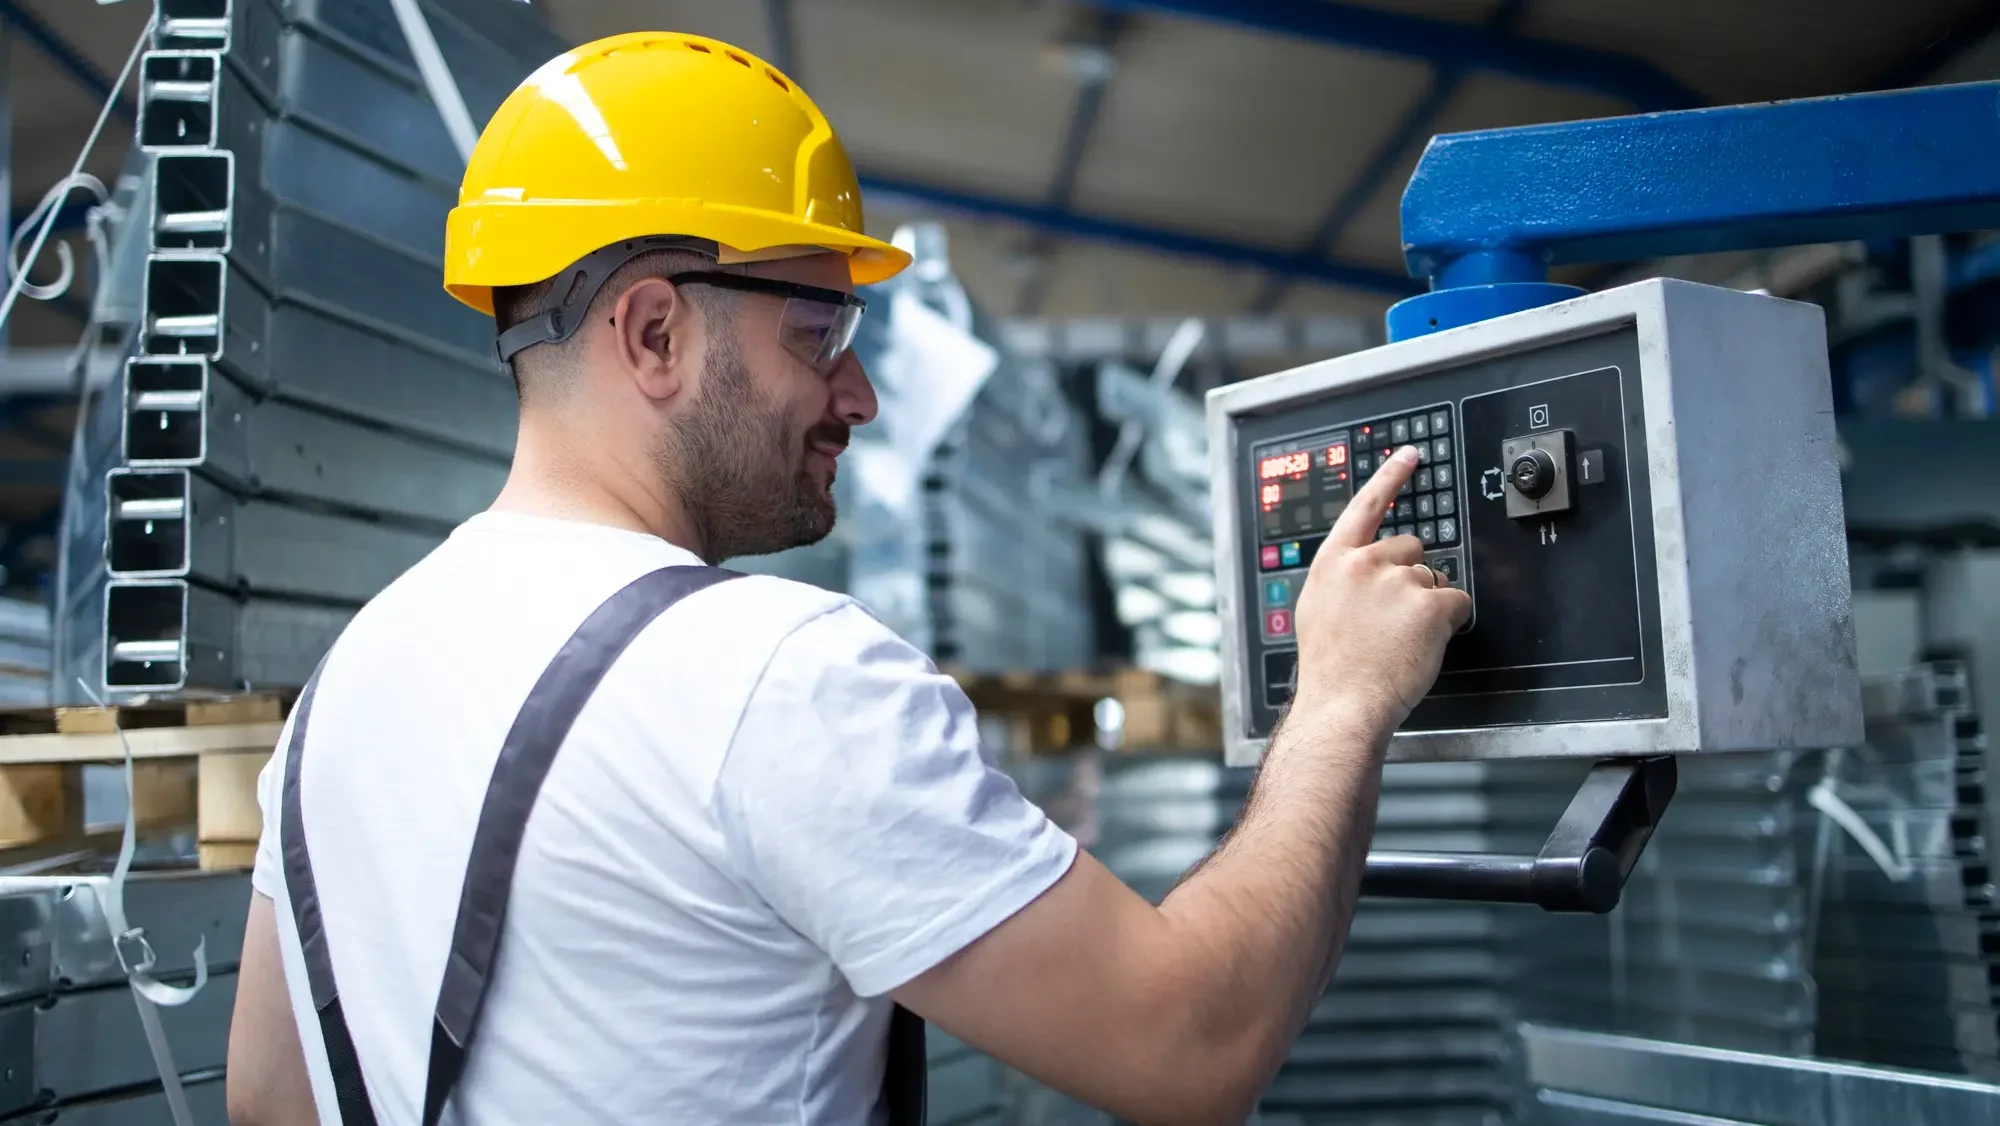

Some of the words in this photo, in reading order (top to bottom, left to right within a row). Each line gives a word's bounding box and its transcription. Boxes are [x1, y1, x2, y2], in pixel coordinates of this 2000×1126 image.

[1396, 424, 1404, 437] 7
[1416, 421, 1424, 433] 8
[1436, 417, 1443, 429] 9
[1438, 444, 1445, 456] 6
[1420, 474, 1427, 486] 2
[1440, 470, 1447, 482] 3
[1421, 500, 1428, 512] 0
[1422, 527, 1430, 539] C
